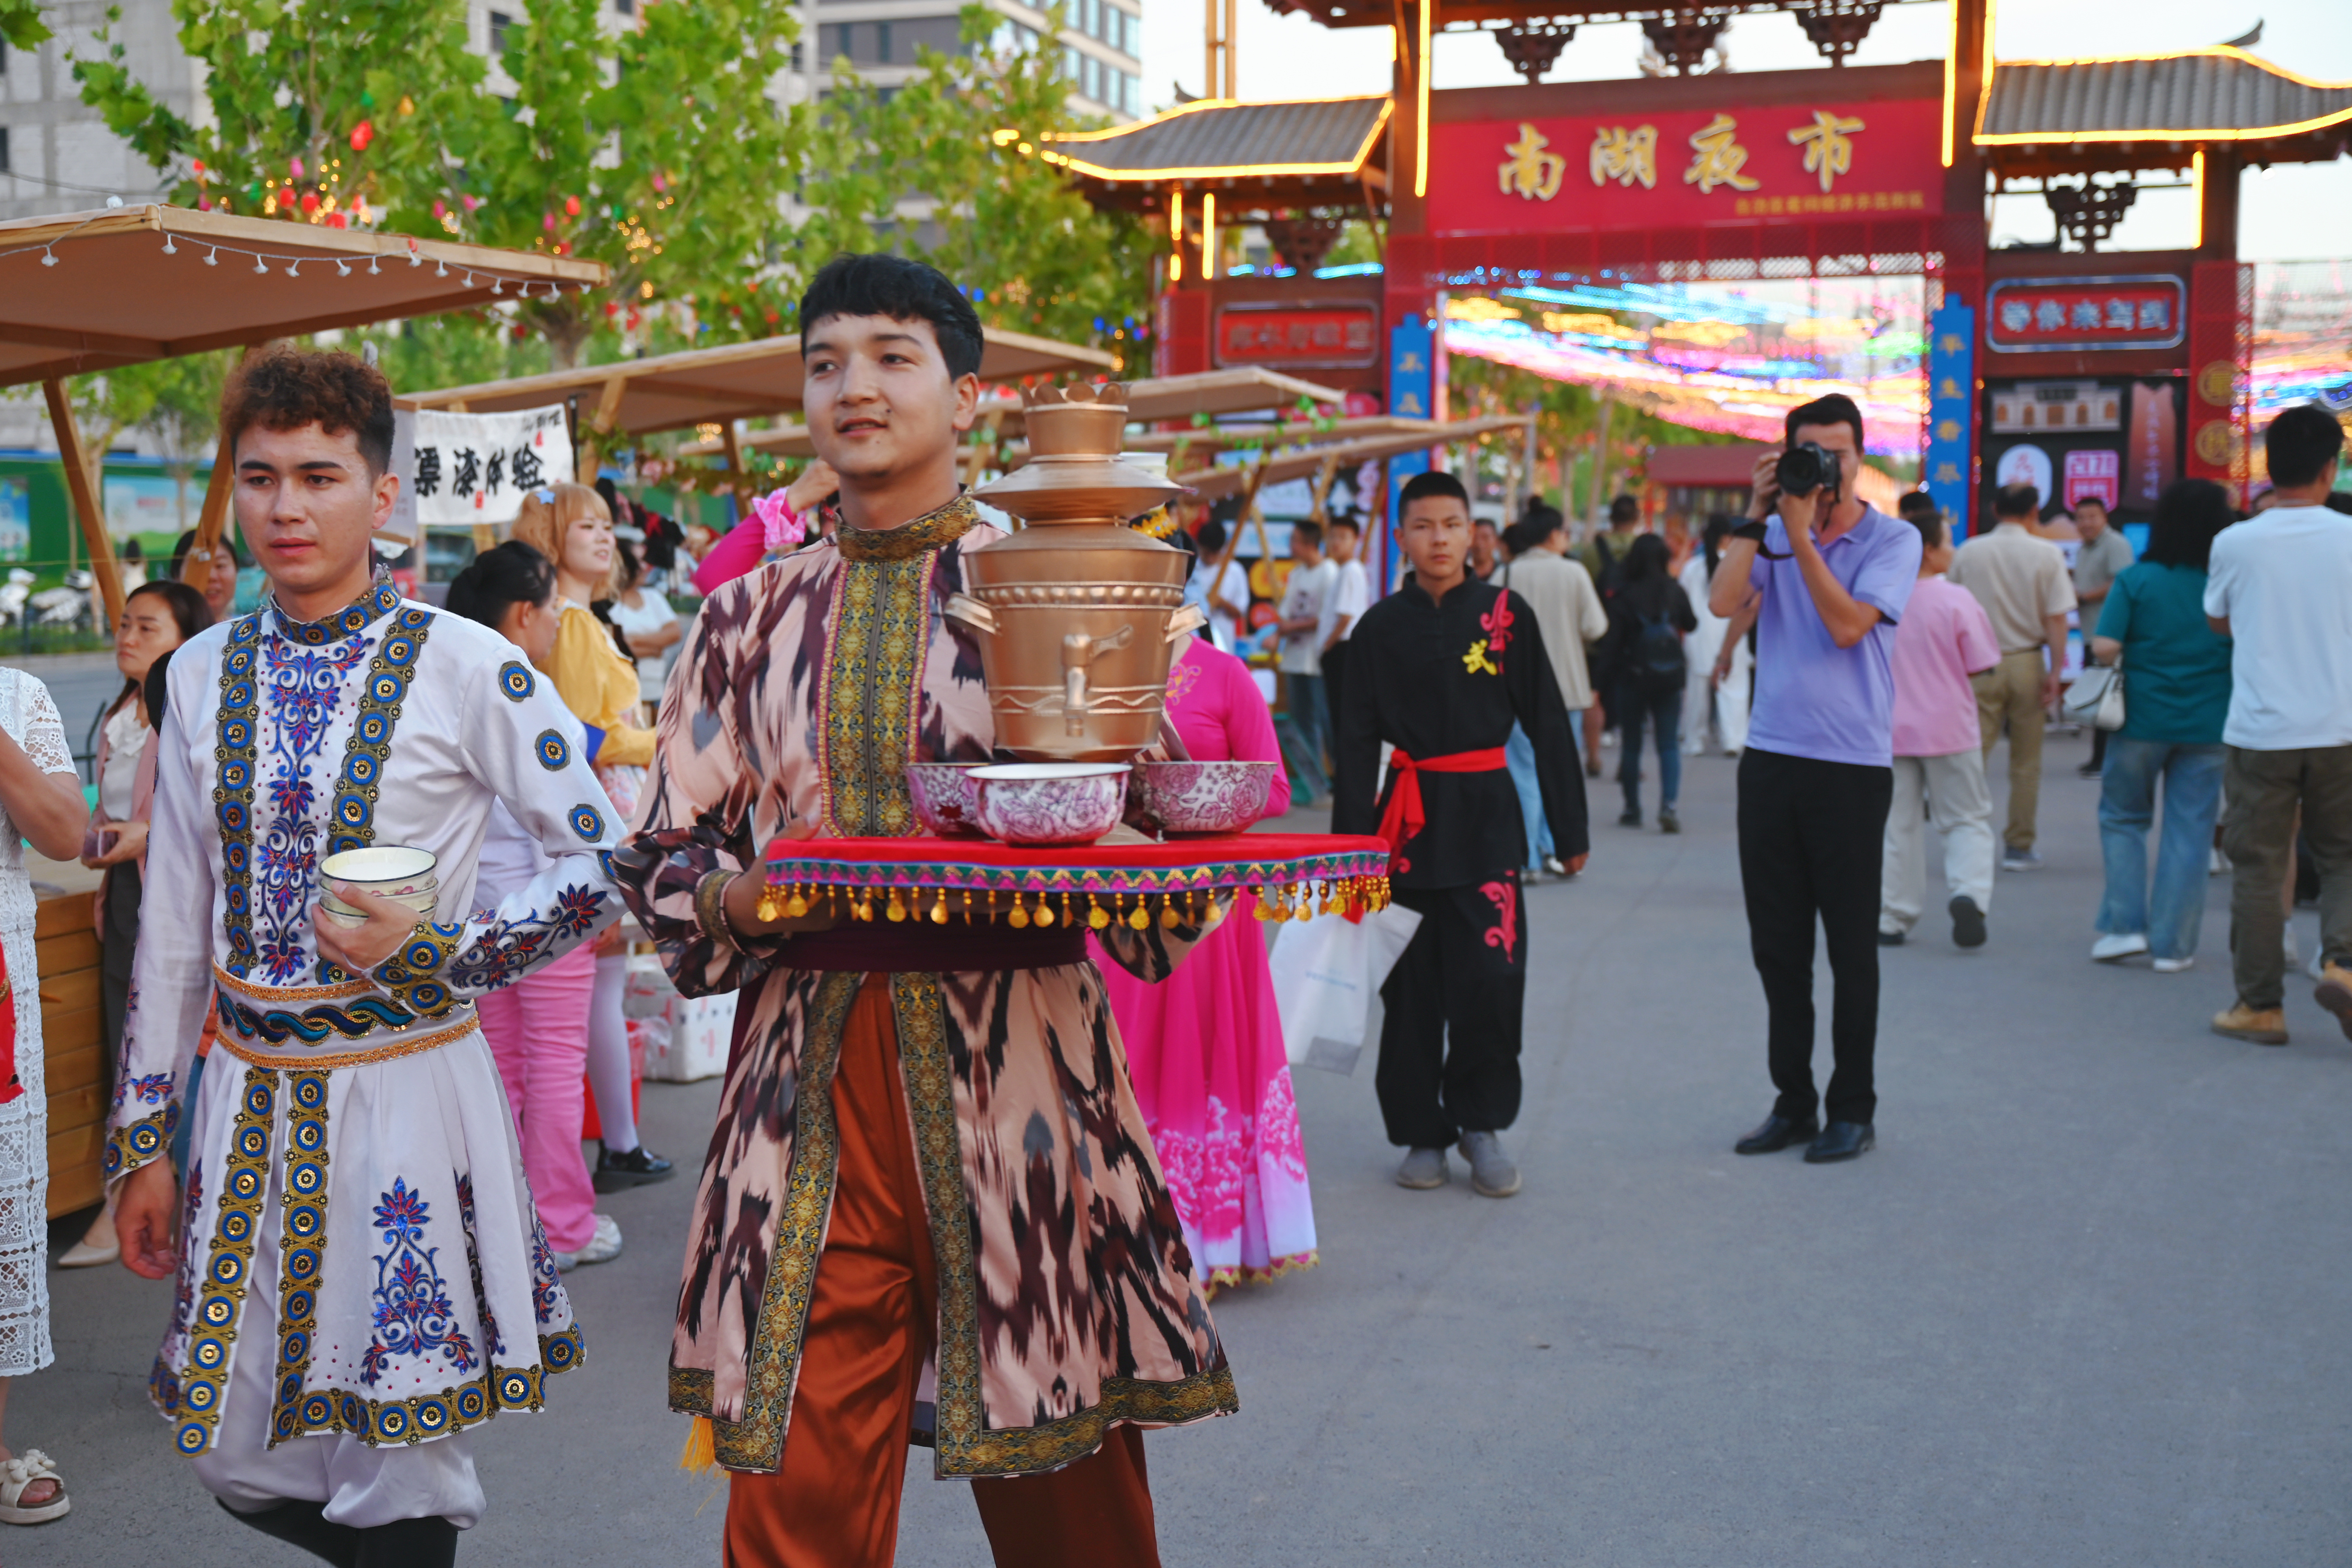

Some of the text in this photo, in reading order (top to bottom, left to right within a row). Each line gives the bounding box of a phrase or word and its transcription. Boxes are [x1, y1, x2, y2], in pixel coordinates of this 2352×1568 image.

[1497, 110, 1865, 202] 南湖夜市
[2001, 297, 2168, 332] 等你来驾到
[1462, 639, 1497, 675] 武
